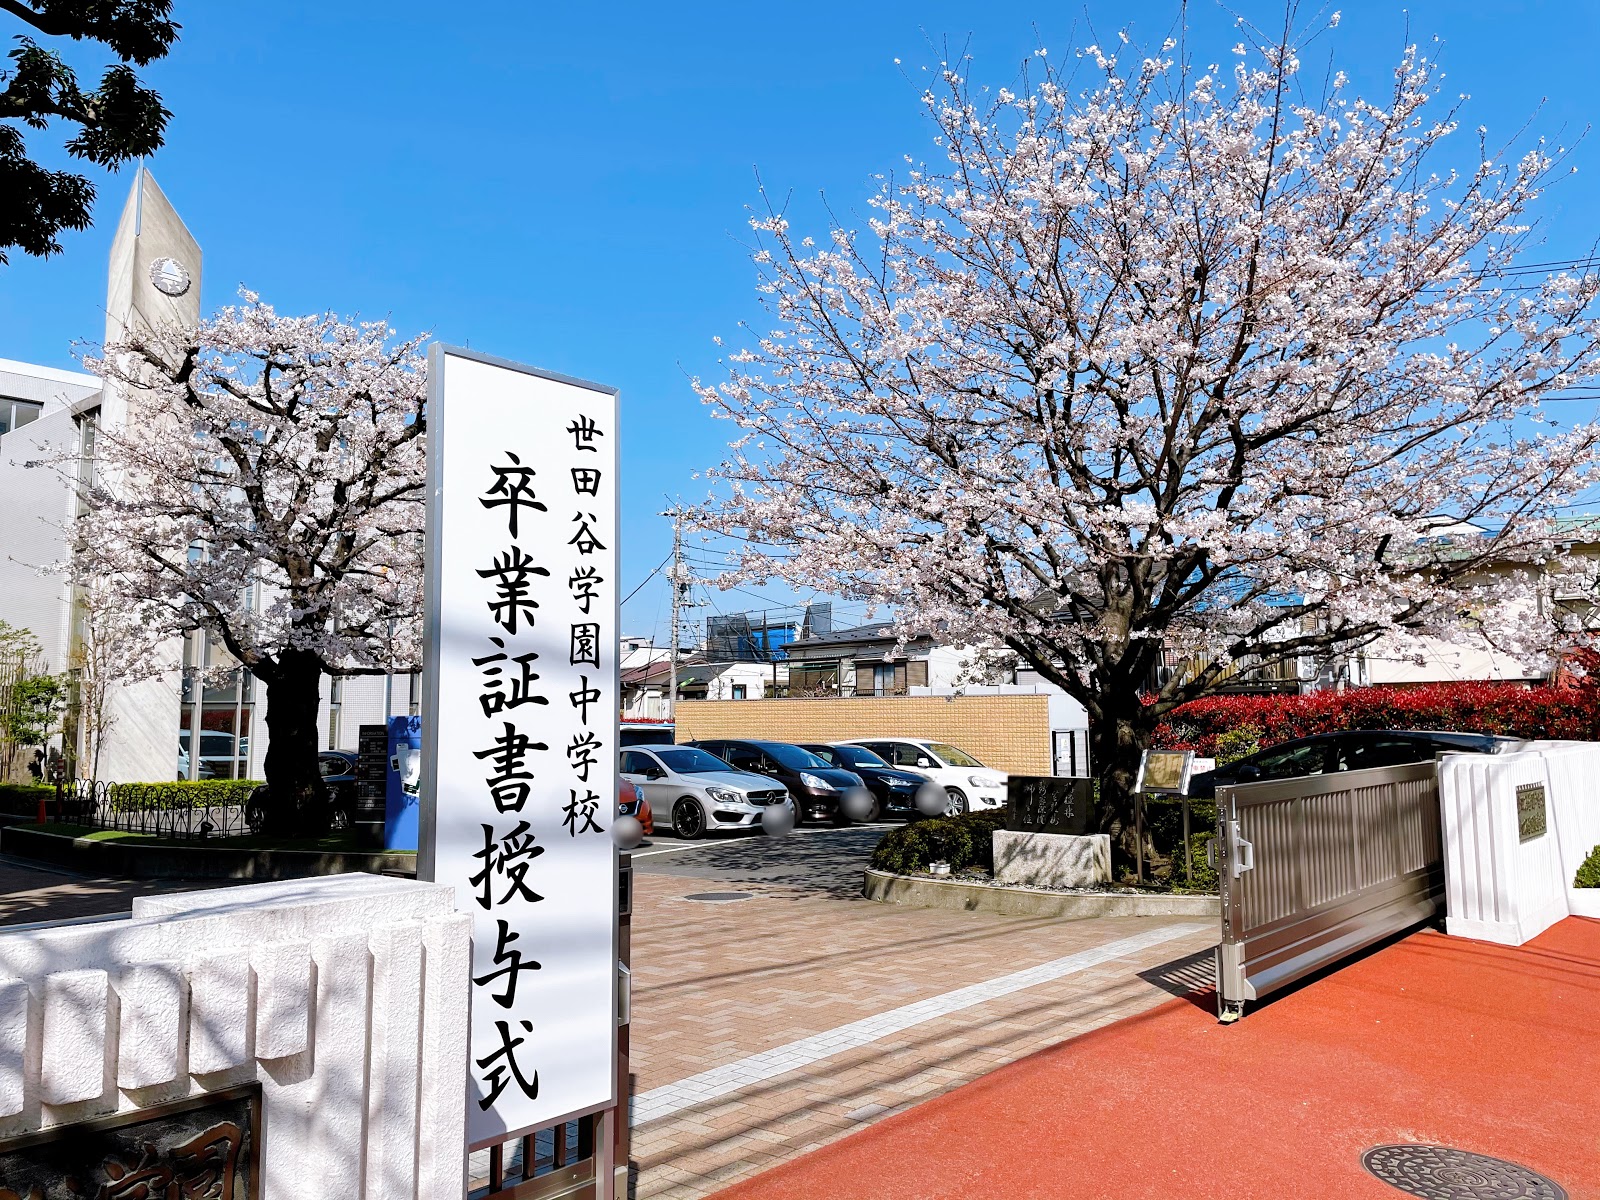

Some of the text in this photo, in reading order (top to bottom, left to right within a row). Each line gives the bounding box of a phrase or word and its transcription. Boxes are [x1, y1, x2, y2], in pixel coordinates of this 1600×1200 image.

[468, 450, 551, 1112] 卒業証書授与式
[562, 413, 607, 838] 世田谷学園中学校
